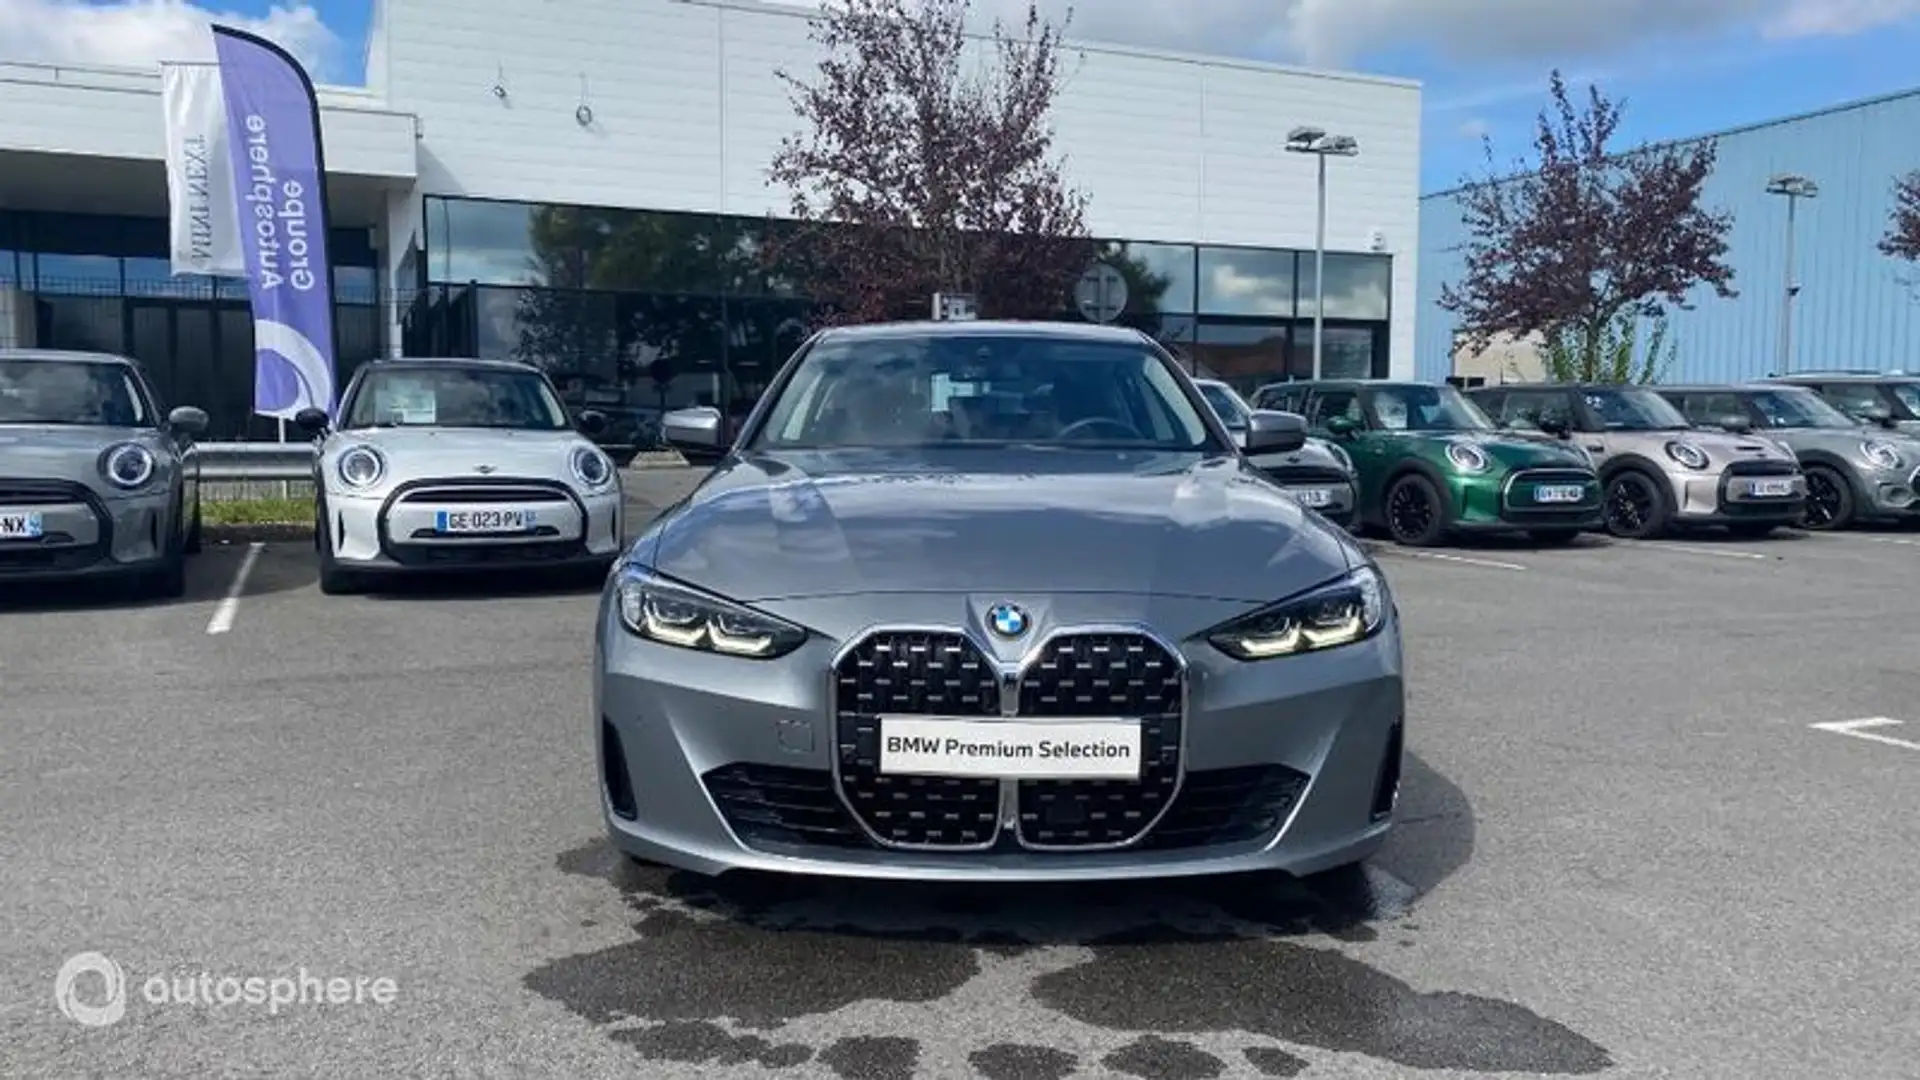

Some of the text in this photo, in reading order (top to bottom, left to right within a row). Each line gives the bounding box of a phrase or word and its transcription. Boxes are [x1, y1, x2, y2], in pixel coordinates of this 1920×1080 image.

[887, 737, 1130, 759] BMW Premium Selection
